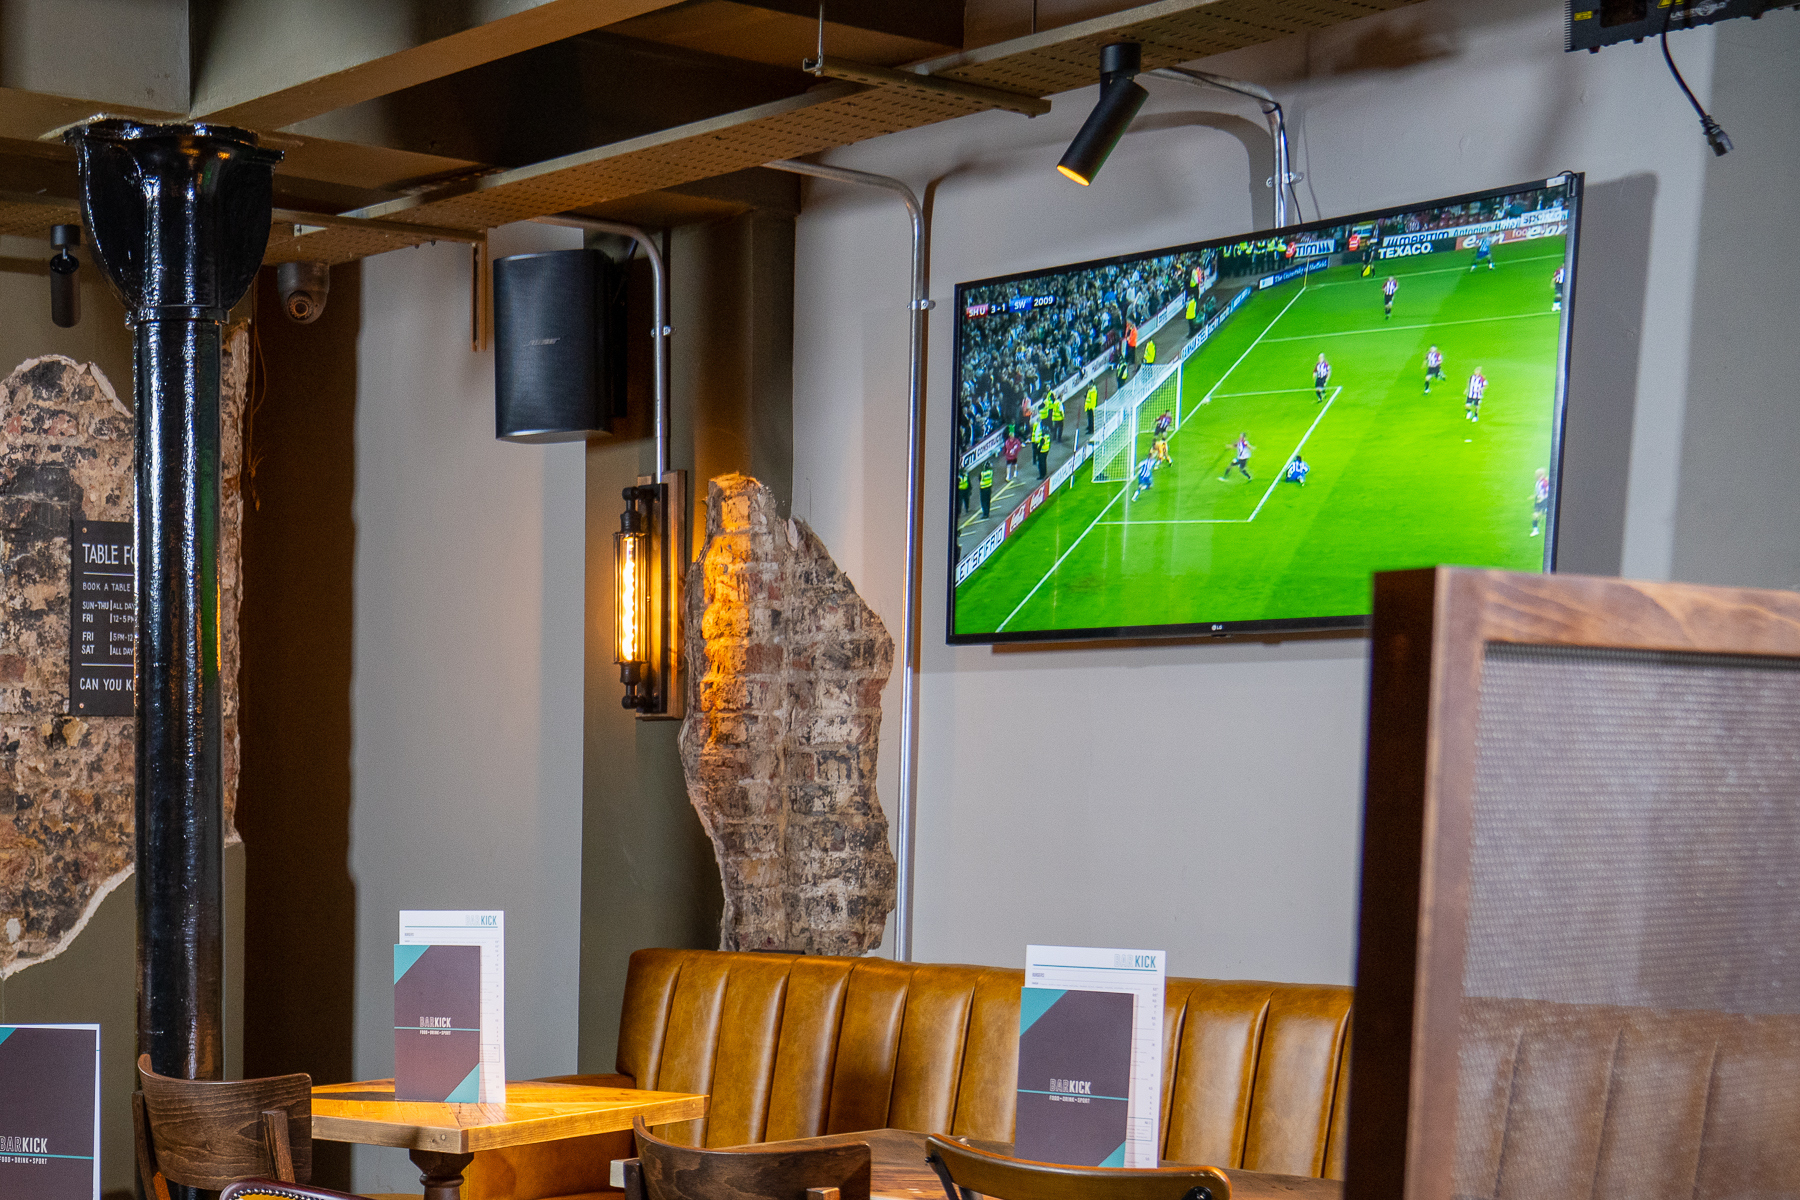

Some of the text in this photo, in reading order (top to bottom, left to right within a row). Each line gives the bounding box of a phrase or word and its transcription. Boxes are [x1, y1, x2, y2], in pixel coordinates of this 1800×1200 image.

[1014, 300, 1027, 310] SW
[1033, 296, 1054, 307] 2009
[82, 543, 119, 565] TABLE
[82, 581, 131, 592] BOOK A TABLE
[82, 601, 135, 611] SUN-THU ALL DAY
[82, 613, 94, 623] FRI
[82, 631, 94, 642] FRI
[81, 644, 134, 656] SAT ALL DAY
[79, 677, 99, 691] CAN
[103, 678, 122, 691] YOU
